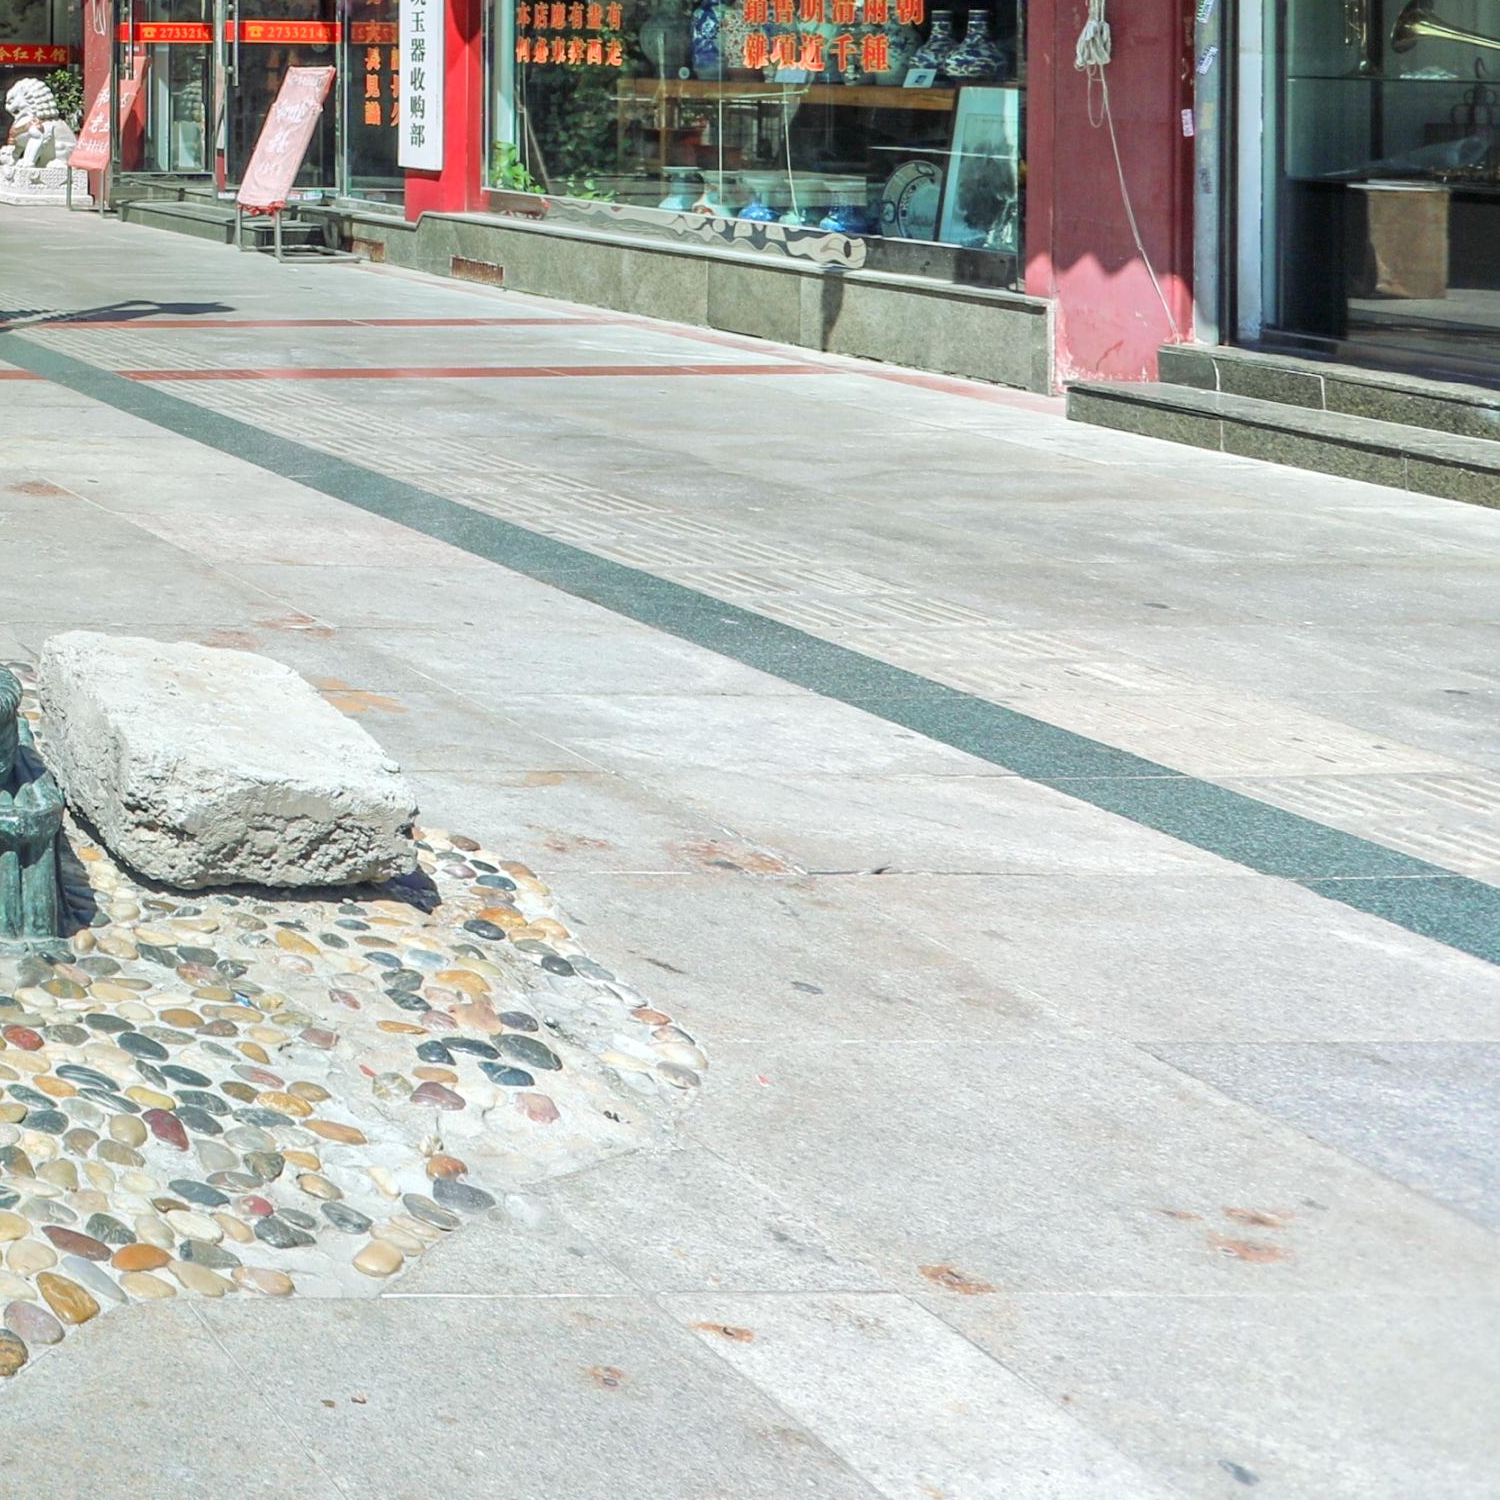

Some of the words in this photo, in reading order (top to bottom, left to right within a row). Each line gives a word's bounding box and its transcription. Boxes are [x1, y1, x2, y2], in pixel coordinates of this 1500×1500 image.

[744, 34, 890, 74] 雜項近千種
